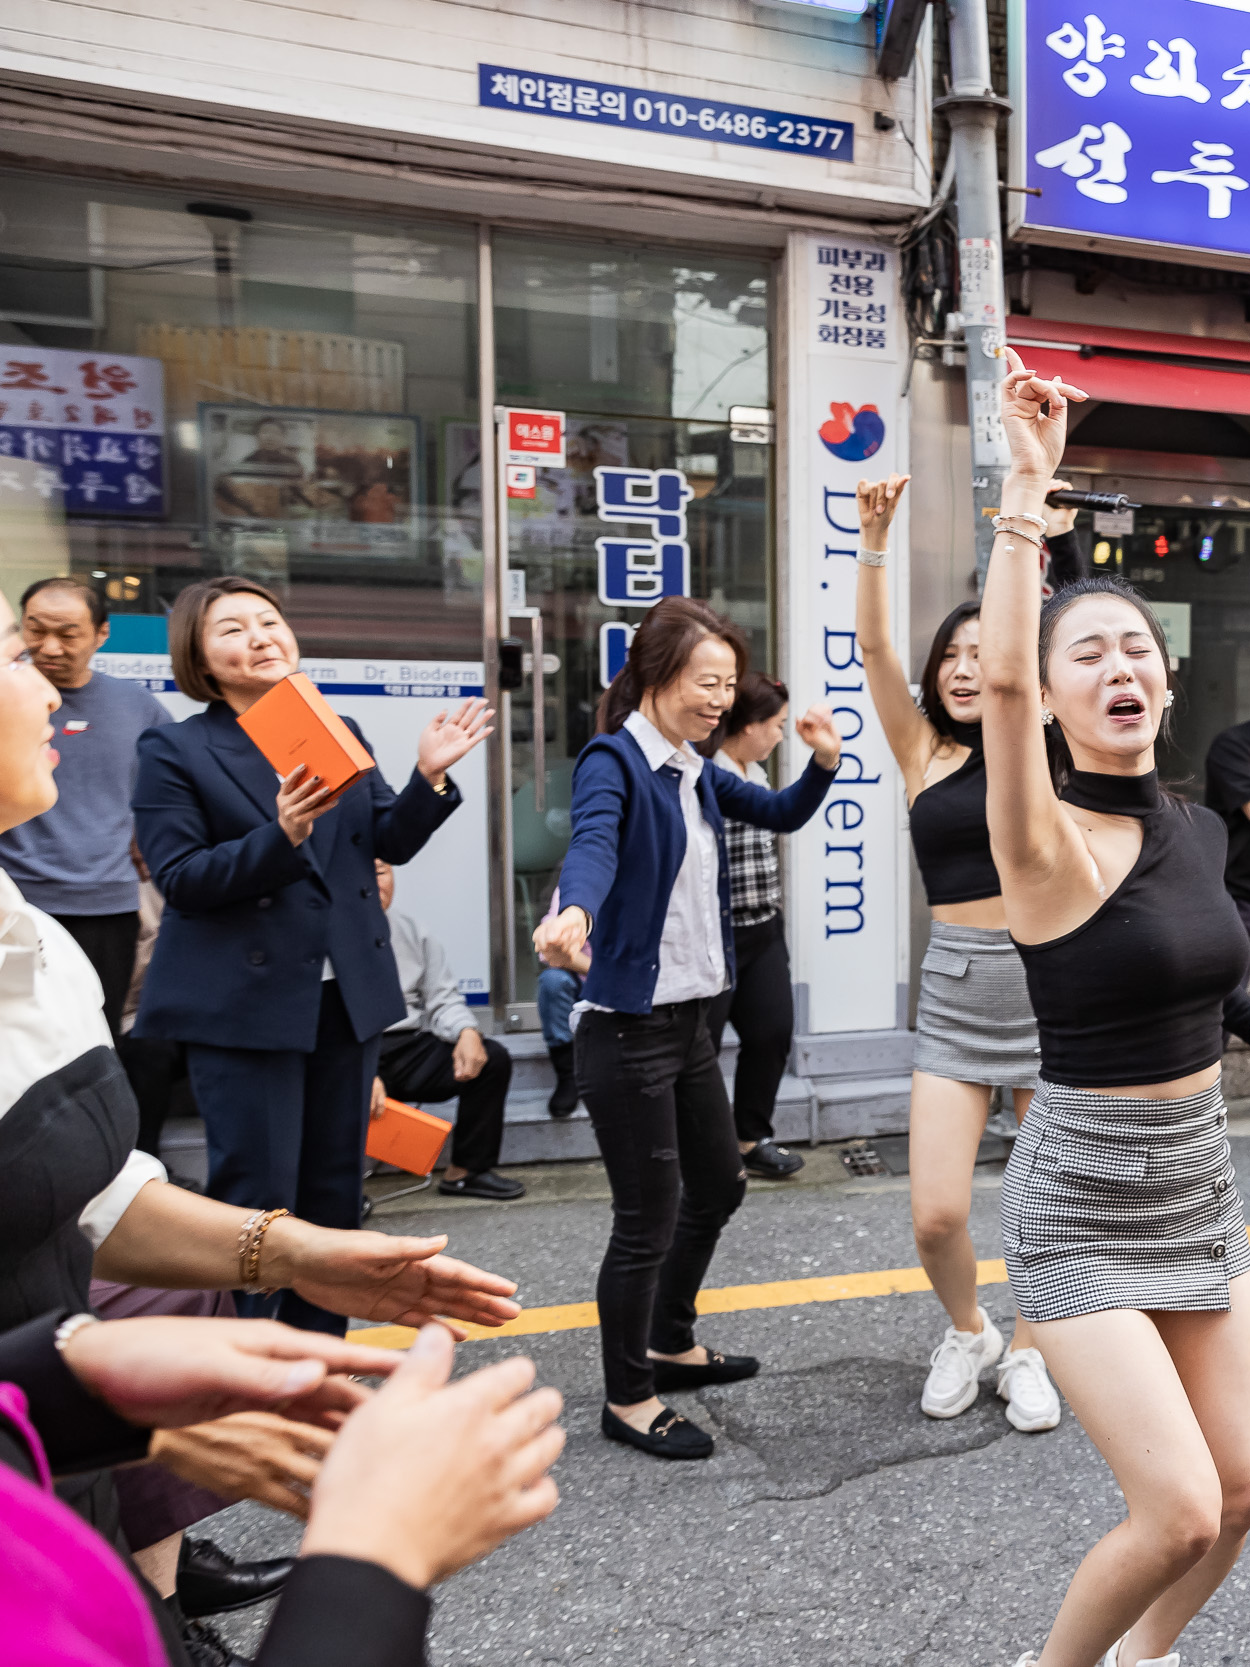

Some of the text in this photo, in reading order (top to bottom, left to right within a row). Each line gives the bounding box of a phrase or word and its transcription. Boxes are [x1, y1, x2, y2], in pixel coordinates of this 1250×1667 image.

[490, 72, 845, 151] 체인점문의 010-6486-2377
[818, 246, 886, 272] 피부과
[828, 272, 874, 297] 전용
[817, 298, 887, 323] 기능성
[818, 324, 887, 349] 화장품
[399, 665, 479, 682] Bioderm
[823, 626, 882, 940] Bioderm
